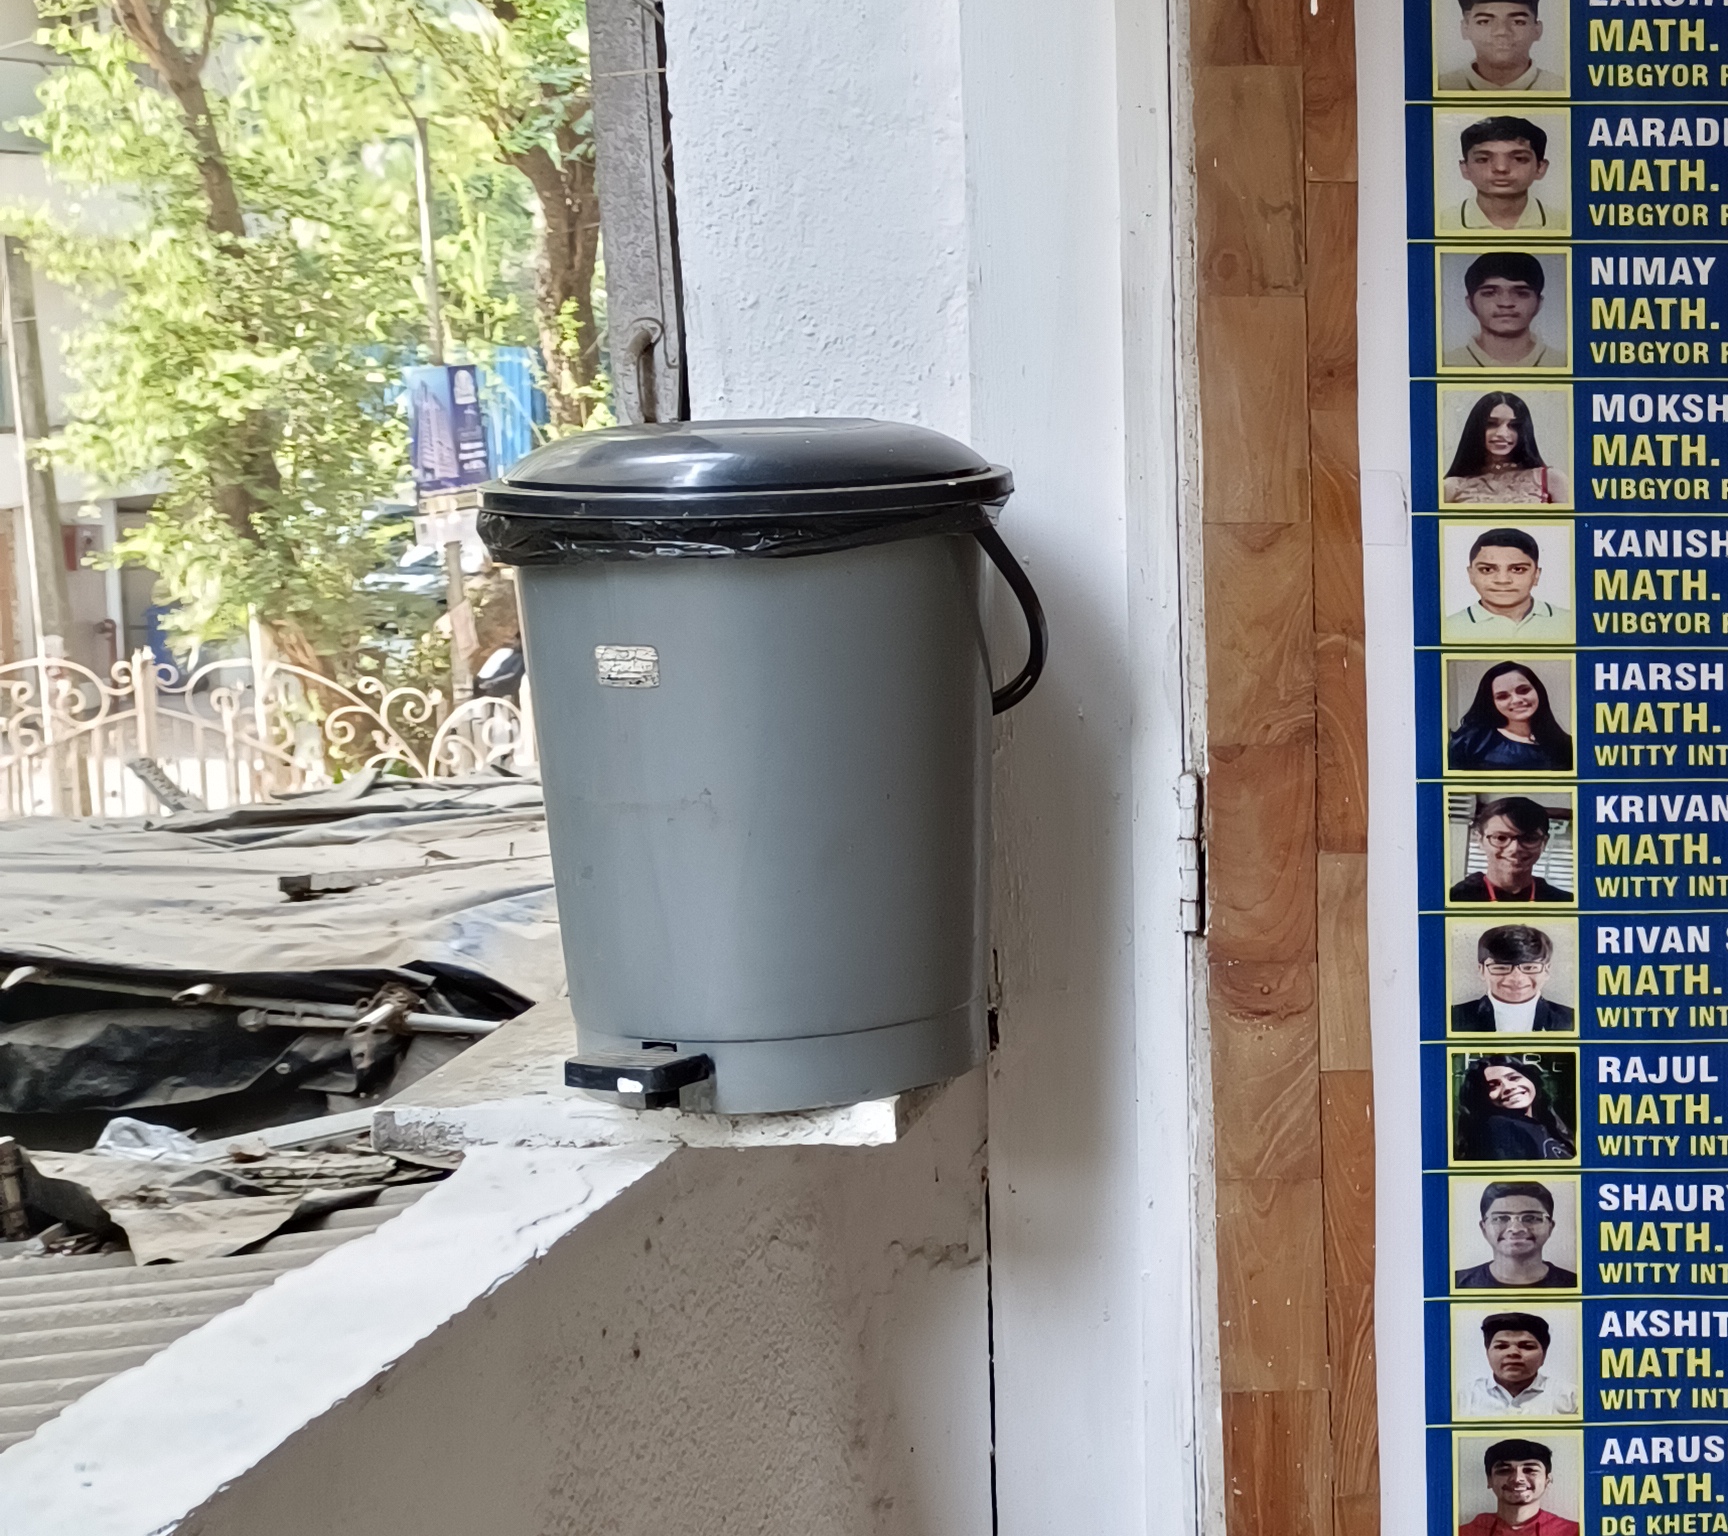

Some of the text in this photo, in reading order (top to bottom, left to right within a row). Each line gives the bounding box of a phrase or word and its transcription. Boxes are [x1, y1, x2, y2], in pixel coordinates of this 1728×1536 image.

[1589, 18, 1719, 52] MATH.
[1587, 63, 1709, 87] VIBGYOR
[1590, 158, 1720, 192] MATH.
[1588, 203, 1709, 227] VIBGYOR
[1591, 256, 1716, 286] NIMAY
[1591, 297, 1720, 330] MATH.
[1589, 340, 1710, 364] VIBGYOR
[1592, 433, 1720, 467] MATH.
[1591, 477, 1710, 500] VIBGYOR
[1594, 568, 1721, 601] MATH.
[1592, 611, 1711, 634] VIBGYOR
[1595, 701, 1722, 734] MATH.
[1594, 744, 1678, 767] WITTY
[1596, 832, 1722, 866] MATH.
[1594, 875, 1679, 898] WITTY
[1597, 925, 1711, 954] RIVAN
[1597, 963, 1723, 996] MATH.
[1596, 1006, 1680, 1028] WITTY
[1598, 1055, 1719, 1084] RAJUL
[1598, 1093, 1723, 1125] MATH.
[1597, 1134, 1681, 1157] WITTY
[1599, 1221, 1724, 1253] MATH.
[1598, 1262, 1681, 1284] WITTY
[1601, 1347, 1725, 1379] MATH.
[1599, 1387, 1682, 1411] WITTY
[1602, 1472, 1725, 1506] MATH.
[1601, 1515, 1636, 1536] DG
